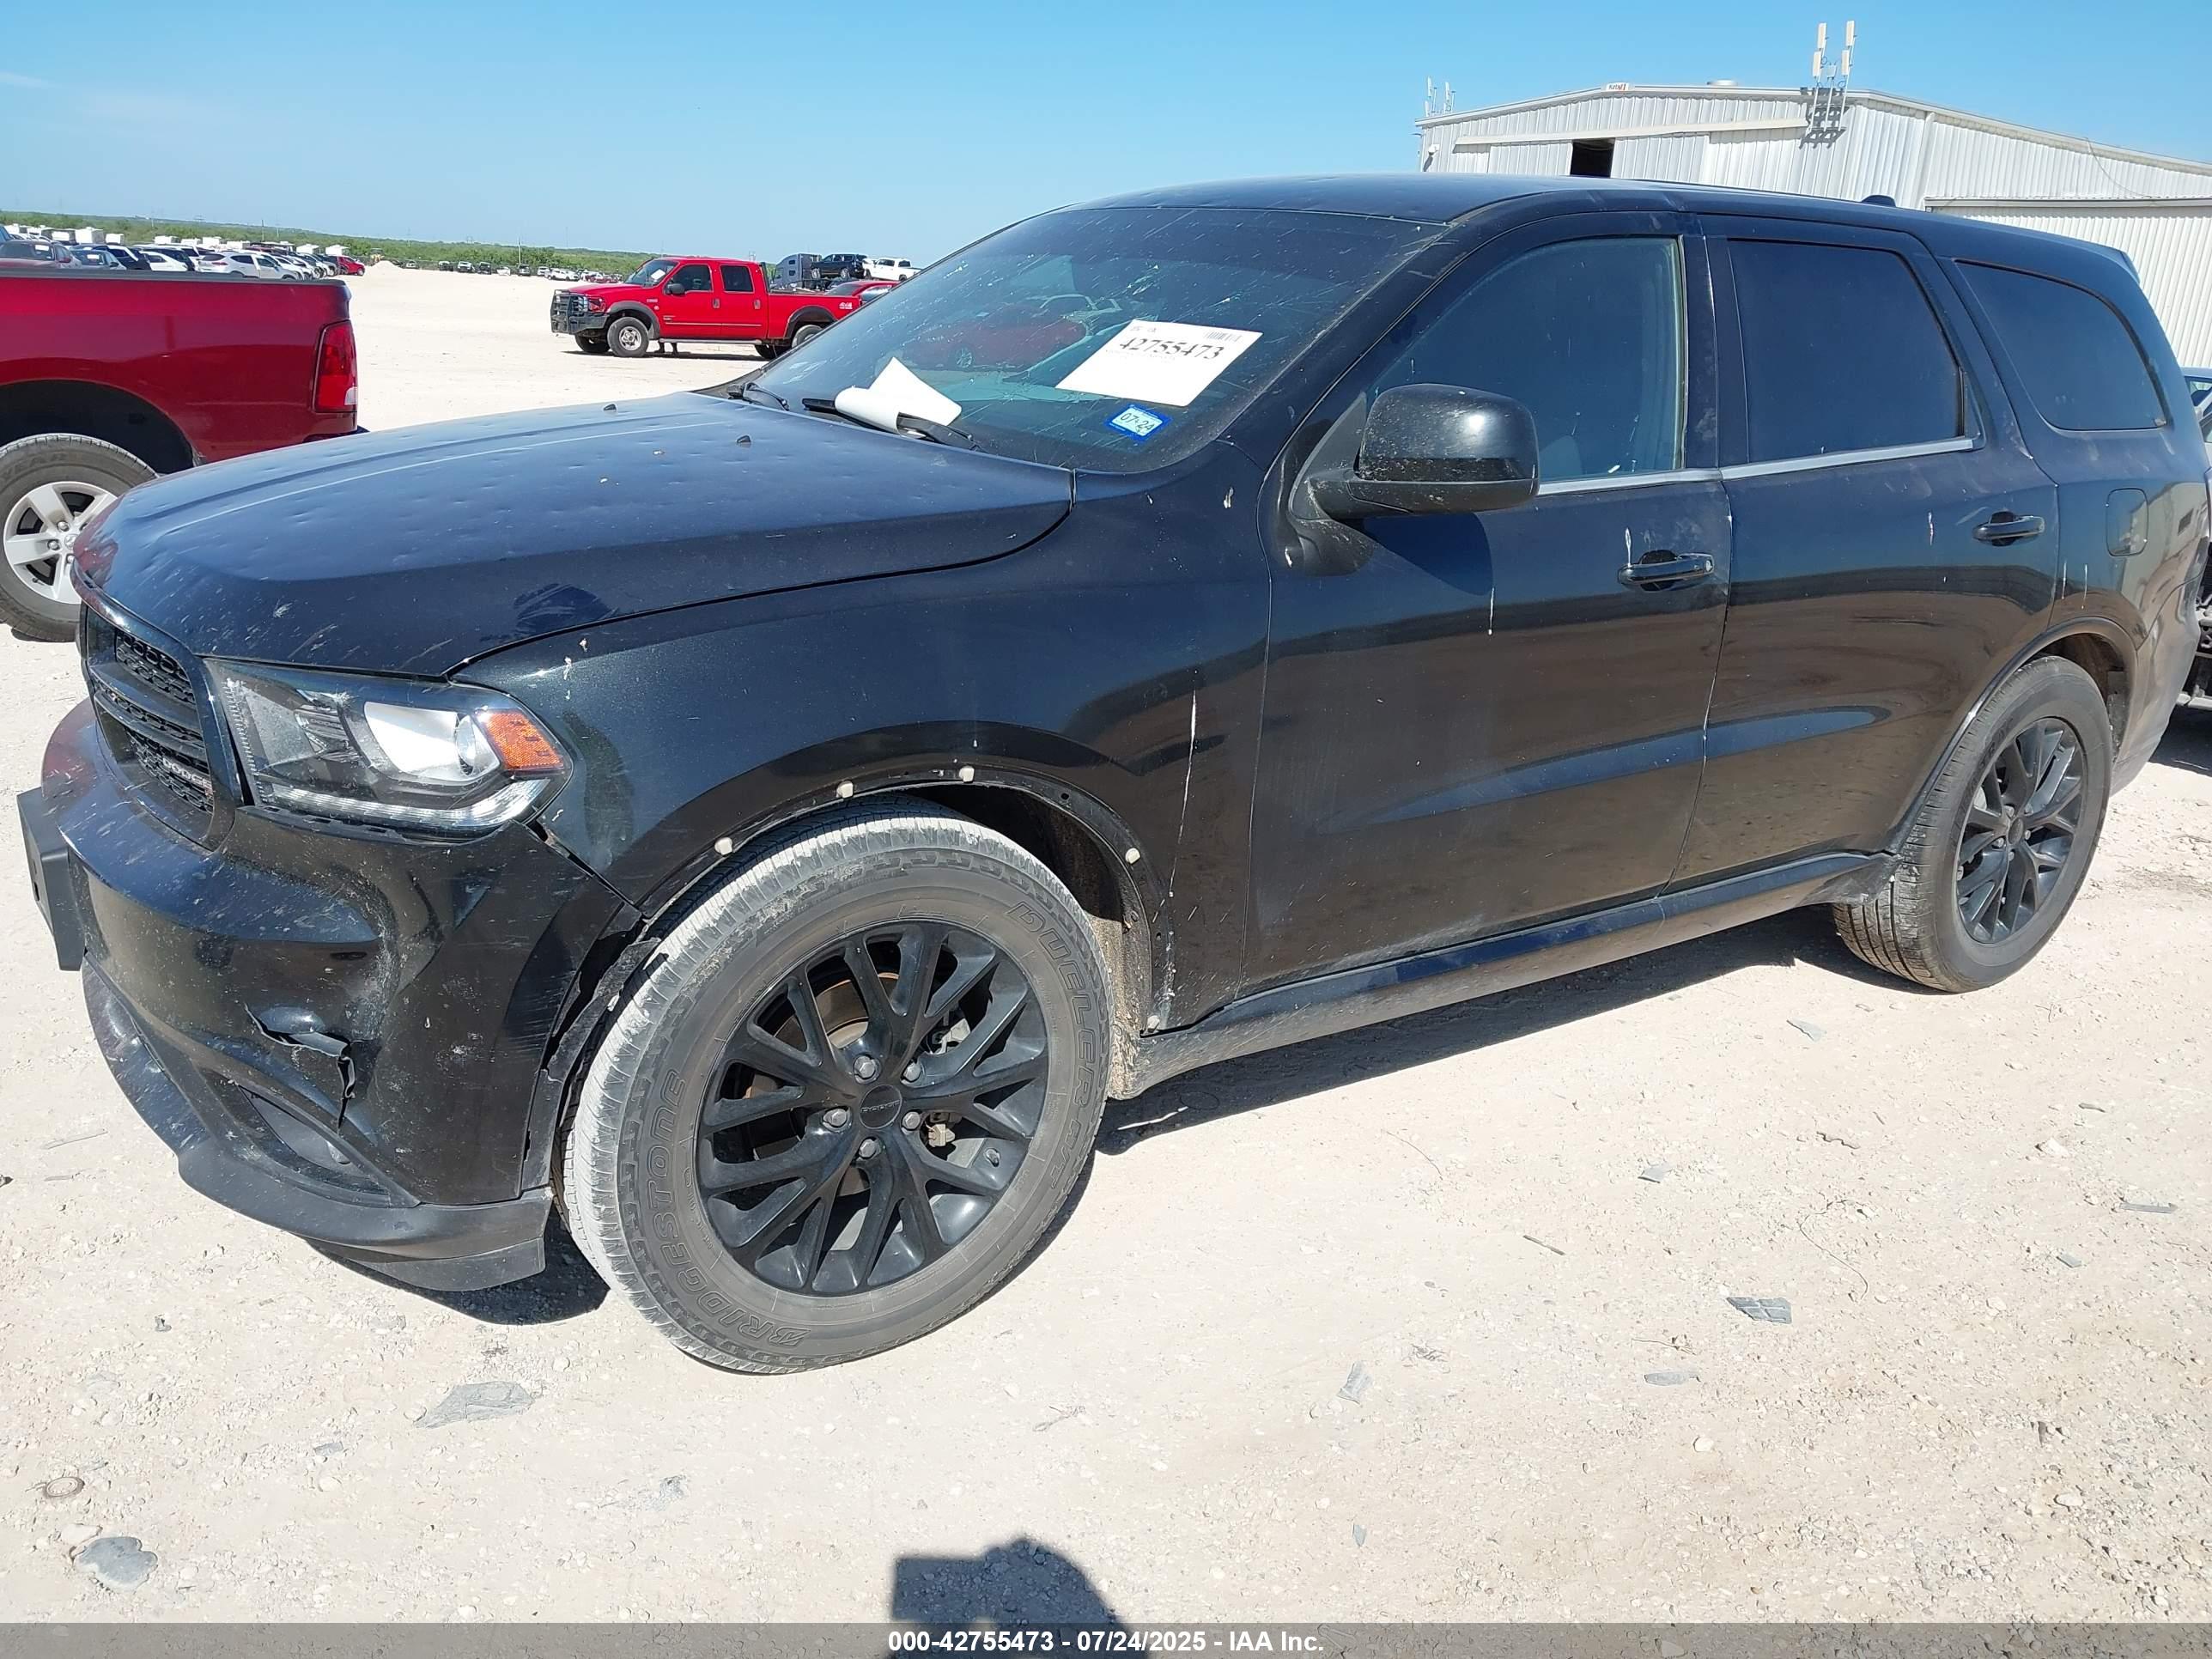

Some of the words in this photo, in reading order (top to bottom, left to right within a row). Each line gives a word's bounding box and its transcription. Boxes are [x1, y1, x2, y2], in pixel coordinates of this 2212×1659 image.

[1119, 337, 1224, 359] 42755473
[1005, 901, 1096, 1108] DUELER
[646, 1069, 811, 1347] BRIDGESTONE
